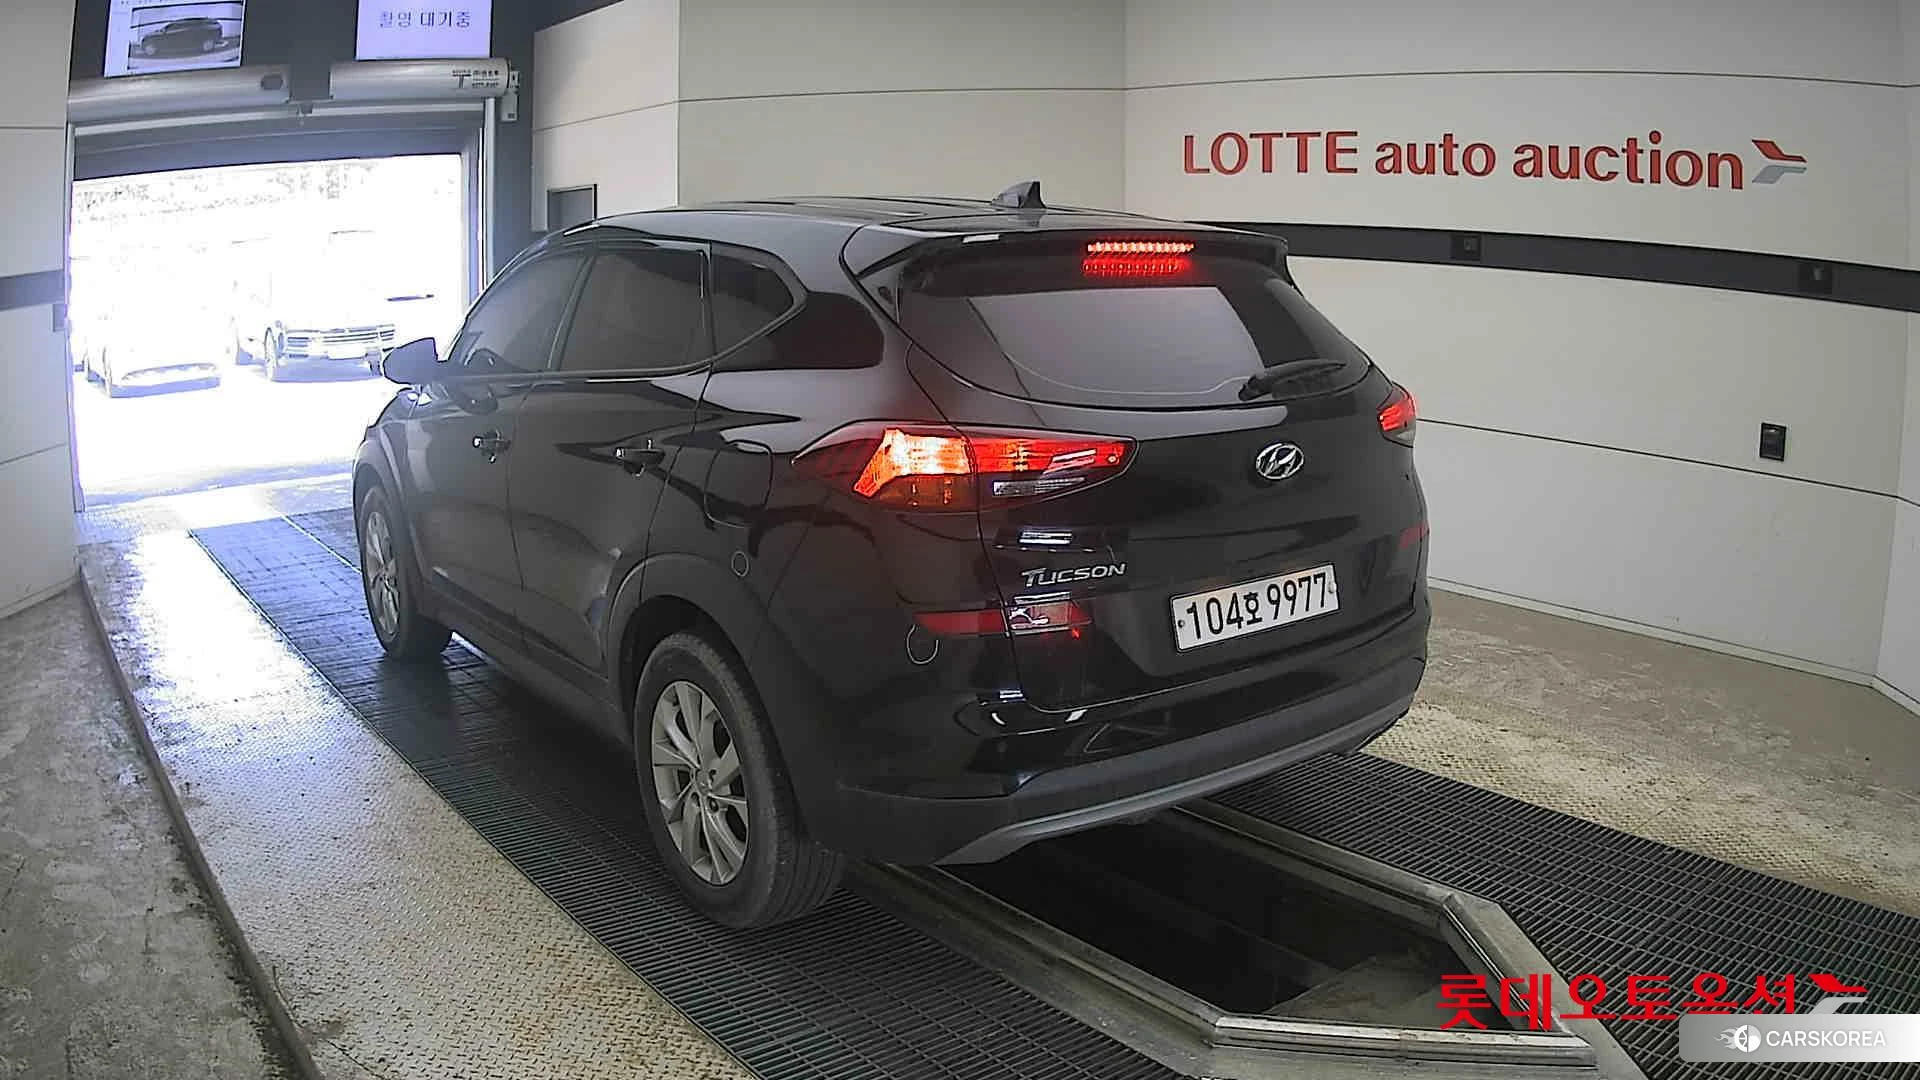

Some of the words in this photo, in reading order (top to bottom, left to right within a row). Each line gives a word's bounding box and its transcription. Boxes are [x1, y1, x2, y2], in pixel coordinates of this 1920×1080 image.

[420, 11, 471, 28] 대기중
[1183, 131, 1358, 175] LOTTE
[1375, 133, 1497, 177] auto
[1512, 130, 1743, 190] auction
[1021, 563, 1127, 587] TUCSON
